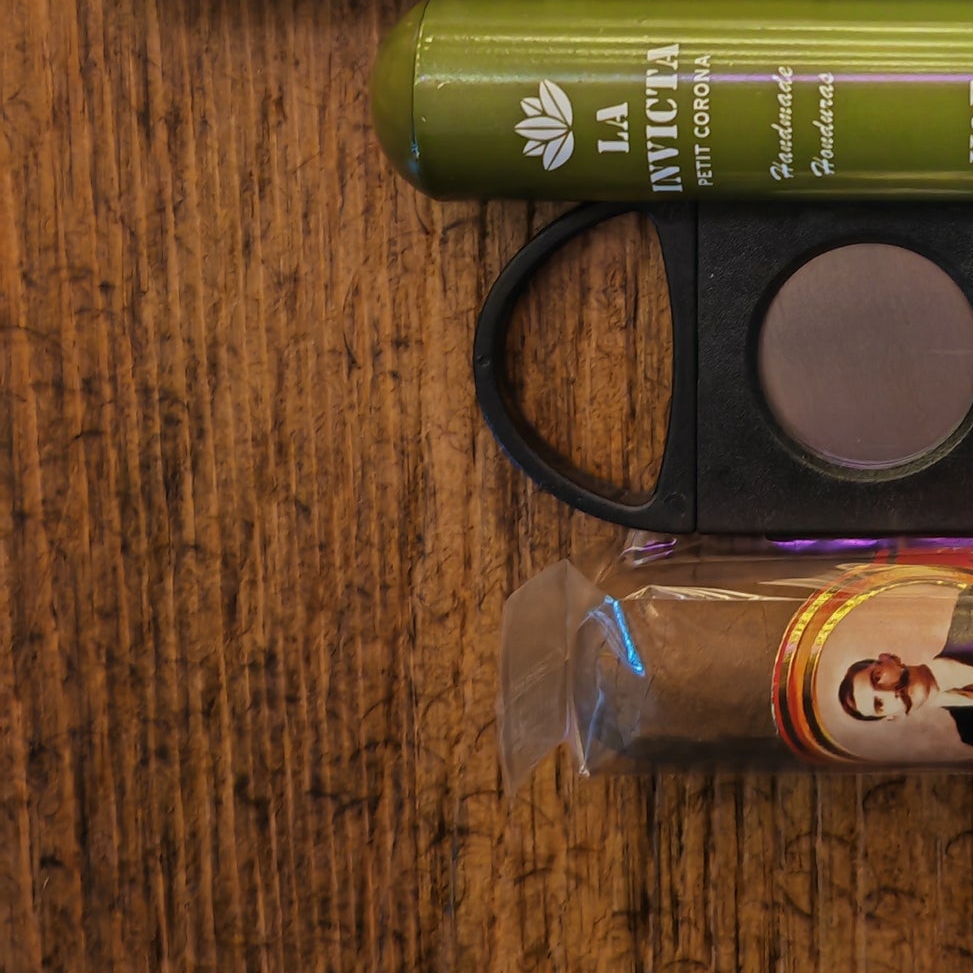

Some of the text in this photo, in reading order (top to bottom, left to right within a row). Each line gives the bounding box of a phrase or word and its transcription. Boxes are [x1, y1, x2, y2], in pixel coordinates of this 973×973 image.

[596, 101, 630, 154] LA
[645, 43, 684, 193] INVICTA
[693, 54, 714, 186] PETIT CORONA
[769, 65, 794, 181] Handmade
[810, 71, 836, 177] Honduras
